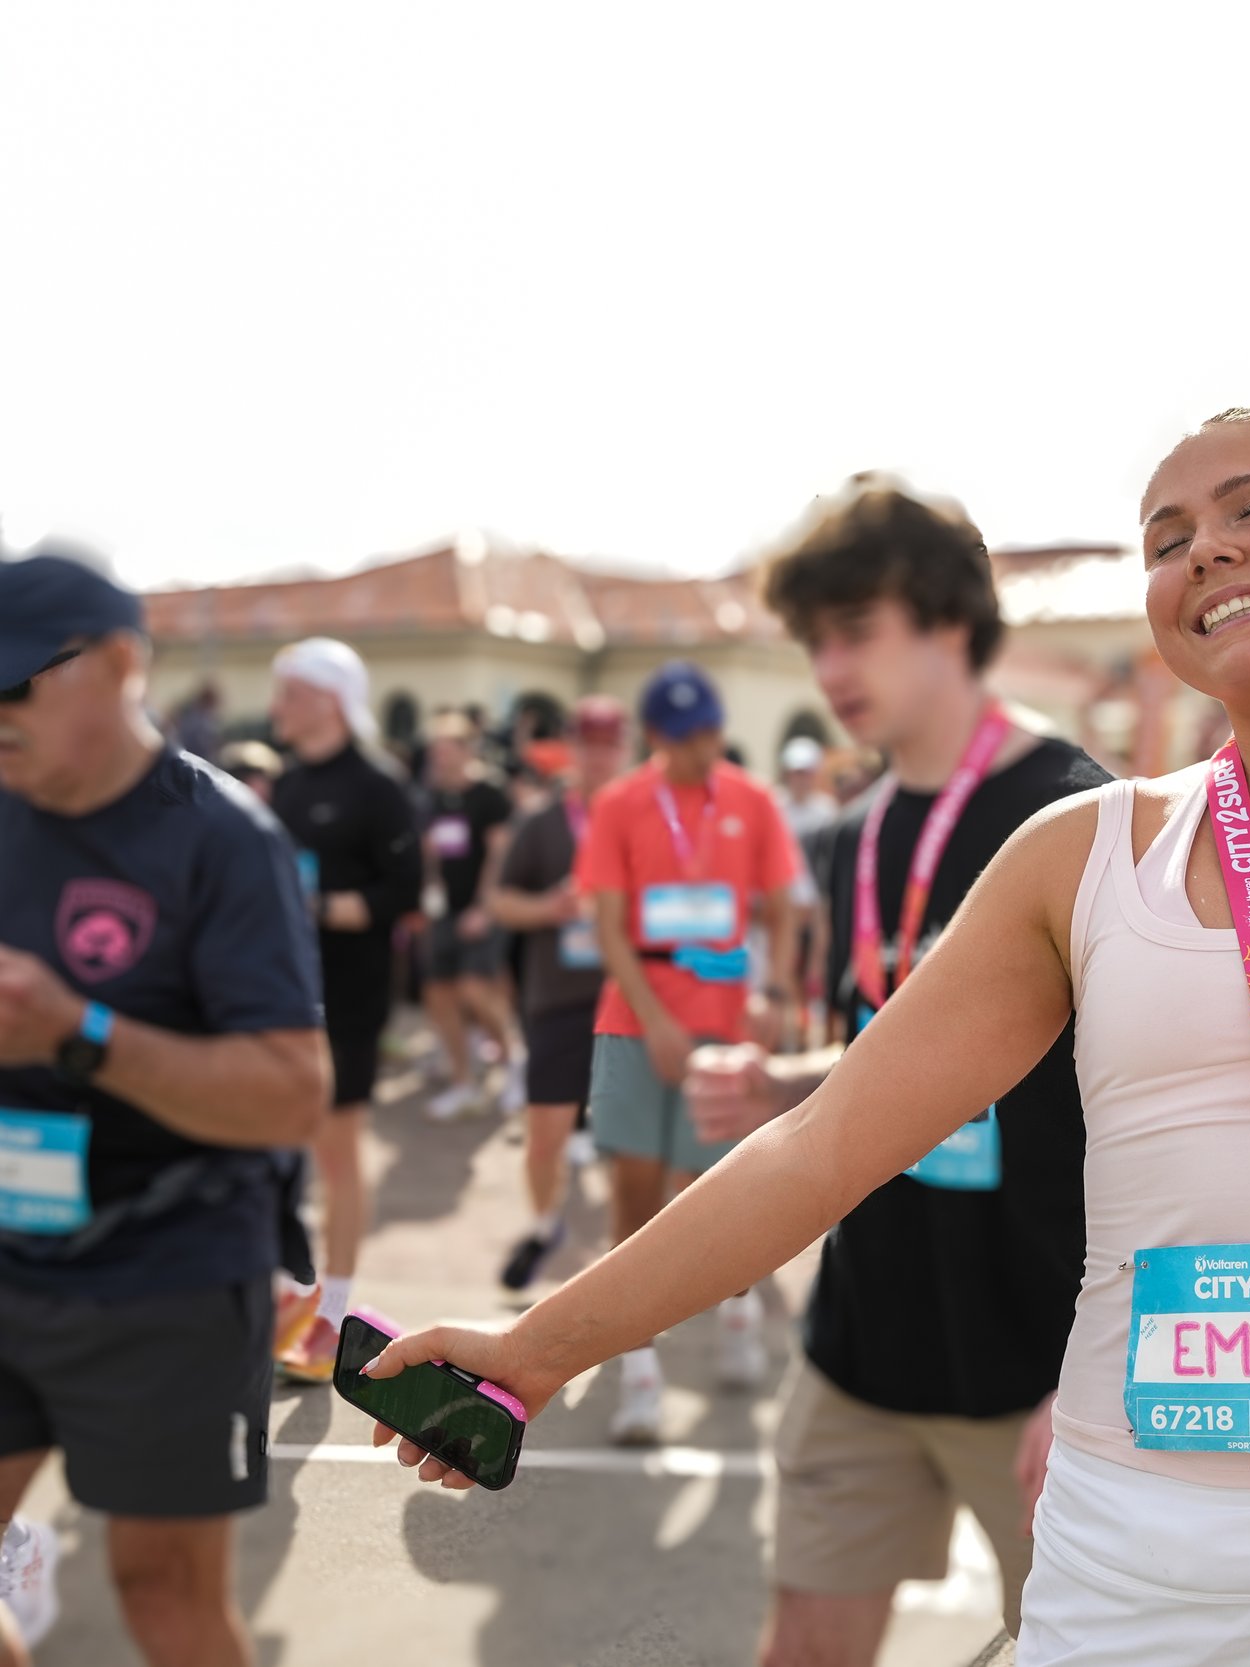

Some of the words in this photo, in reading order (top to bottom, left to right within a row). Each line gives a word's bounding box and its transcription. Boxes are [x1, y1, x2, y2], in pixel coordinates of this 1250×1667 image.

[1206, 1259, 1249, 1271] Voltaren
[1140, 1317, 1155, 1336] NAME
[1144, 1324, 1159, 1341] HERE
[1150, 1404, 1234, 1431] 67218
